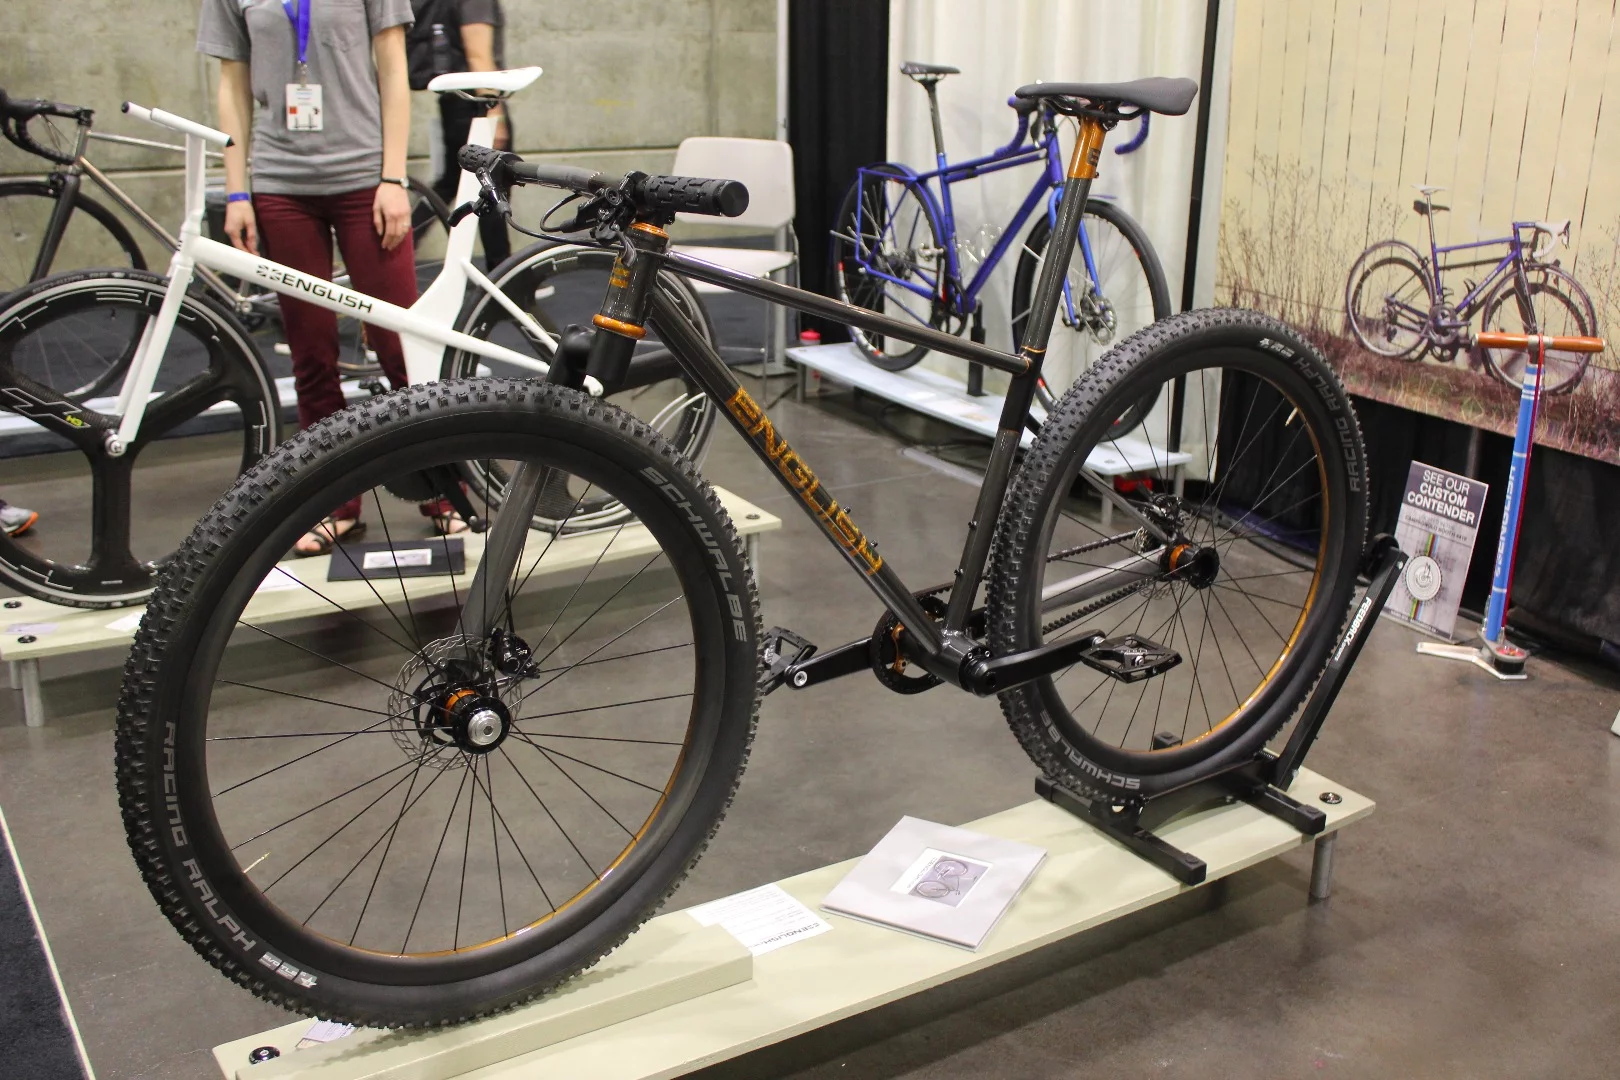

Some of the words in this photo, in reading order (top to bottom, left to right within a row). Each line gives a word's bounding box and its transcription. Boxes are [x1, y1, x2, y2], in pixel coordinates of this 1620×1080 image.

[281, 273, 373, 313] ENGLISH
[726, 386, 883, 576] ENGLISH
[1407, 493, 1475, 525] CONTENDER
[1420, 484, 1468, 508] CUSTOM
[1423, 469, 1444, 486] SEE
[1445, 477, 1470, 496] OUR
[1497, 465, 1516, 555] ENGLISH
[639, 466, 748, 642] SCHWALBE
[1344, 596, 1372, 646] FEEDBACK
[1040, 709, 1140, 789] SCHWALBE
[163, 720, 188, 847] RACING
[182, 857, 257, 951] RALPH
